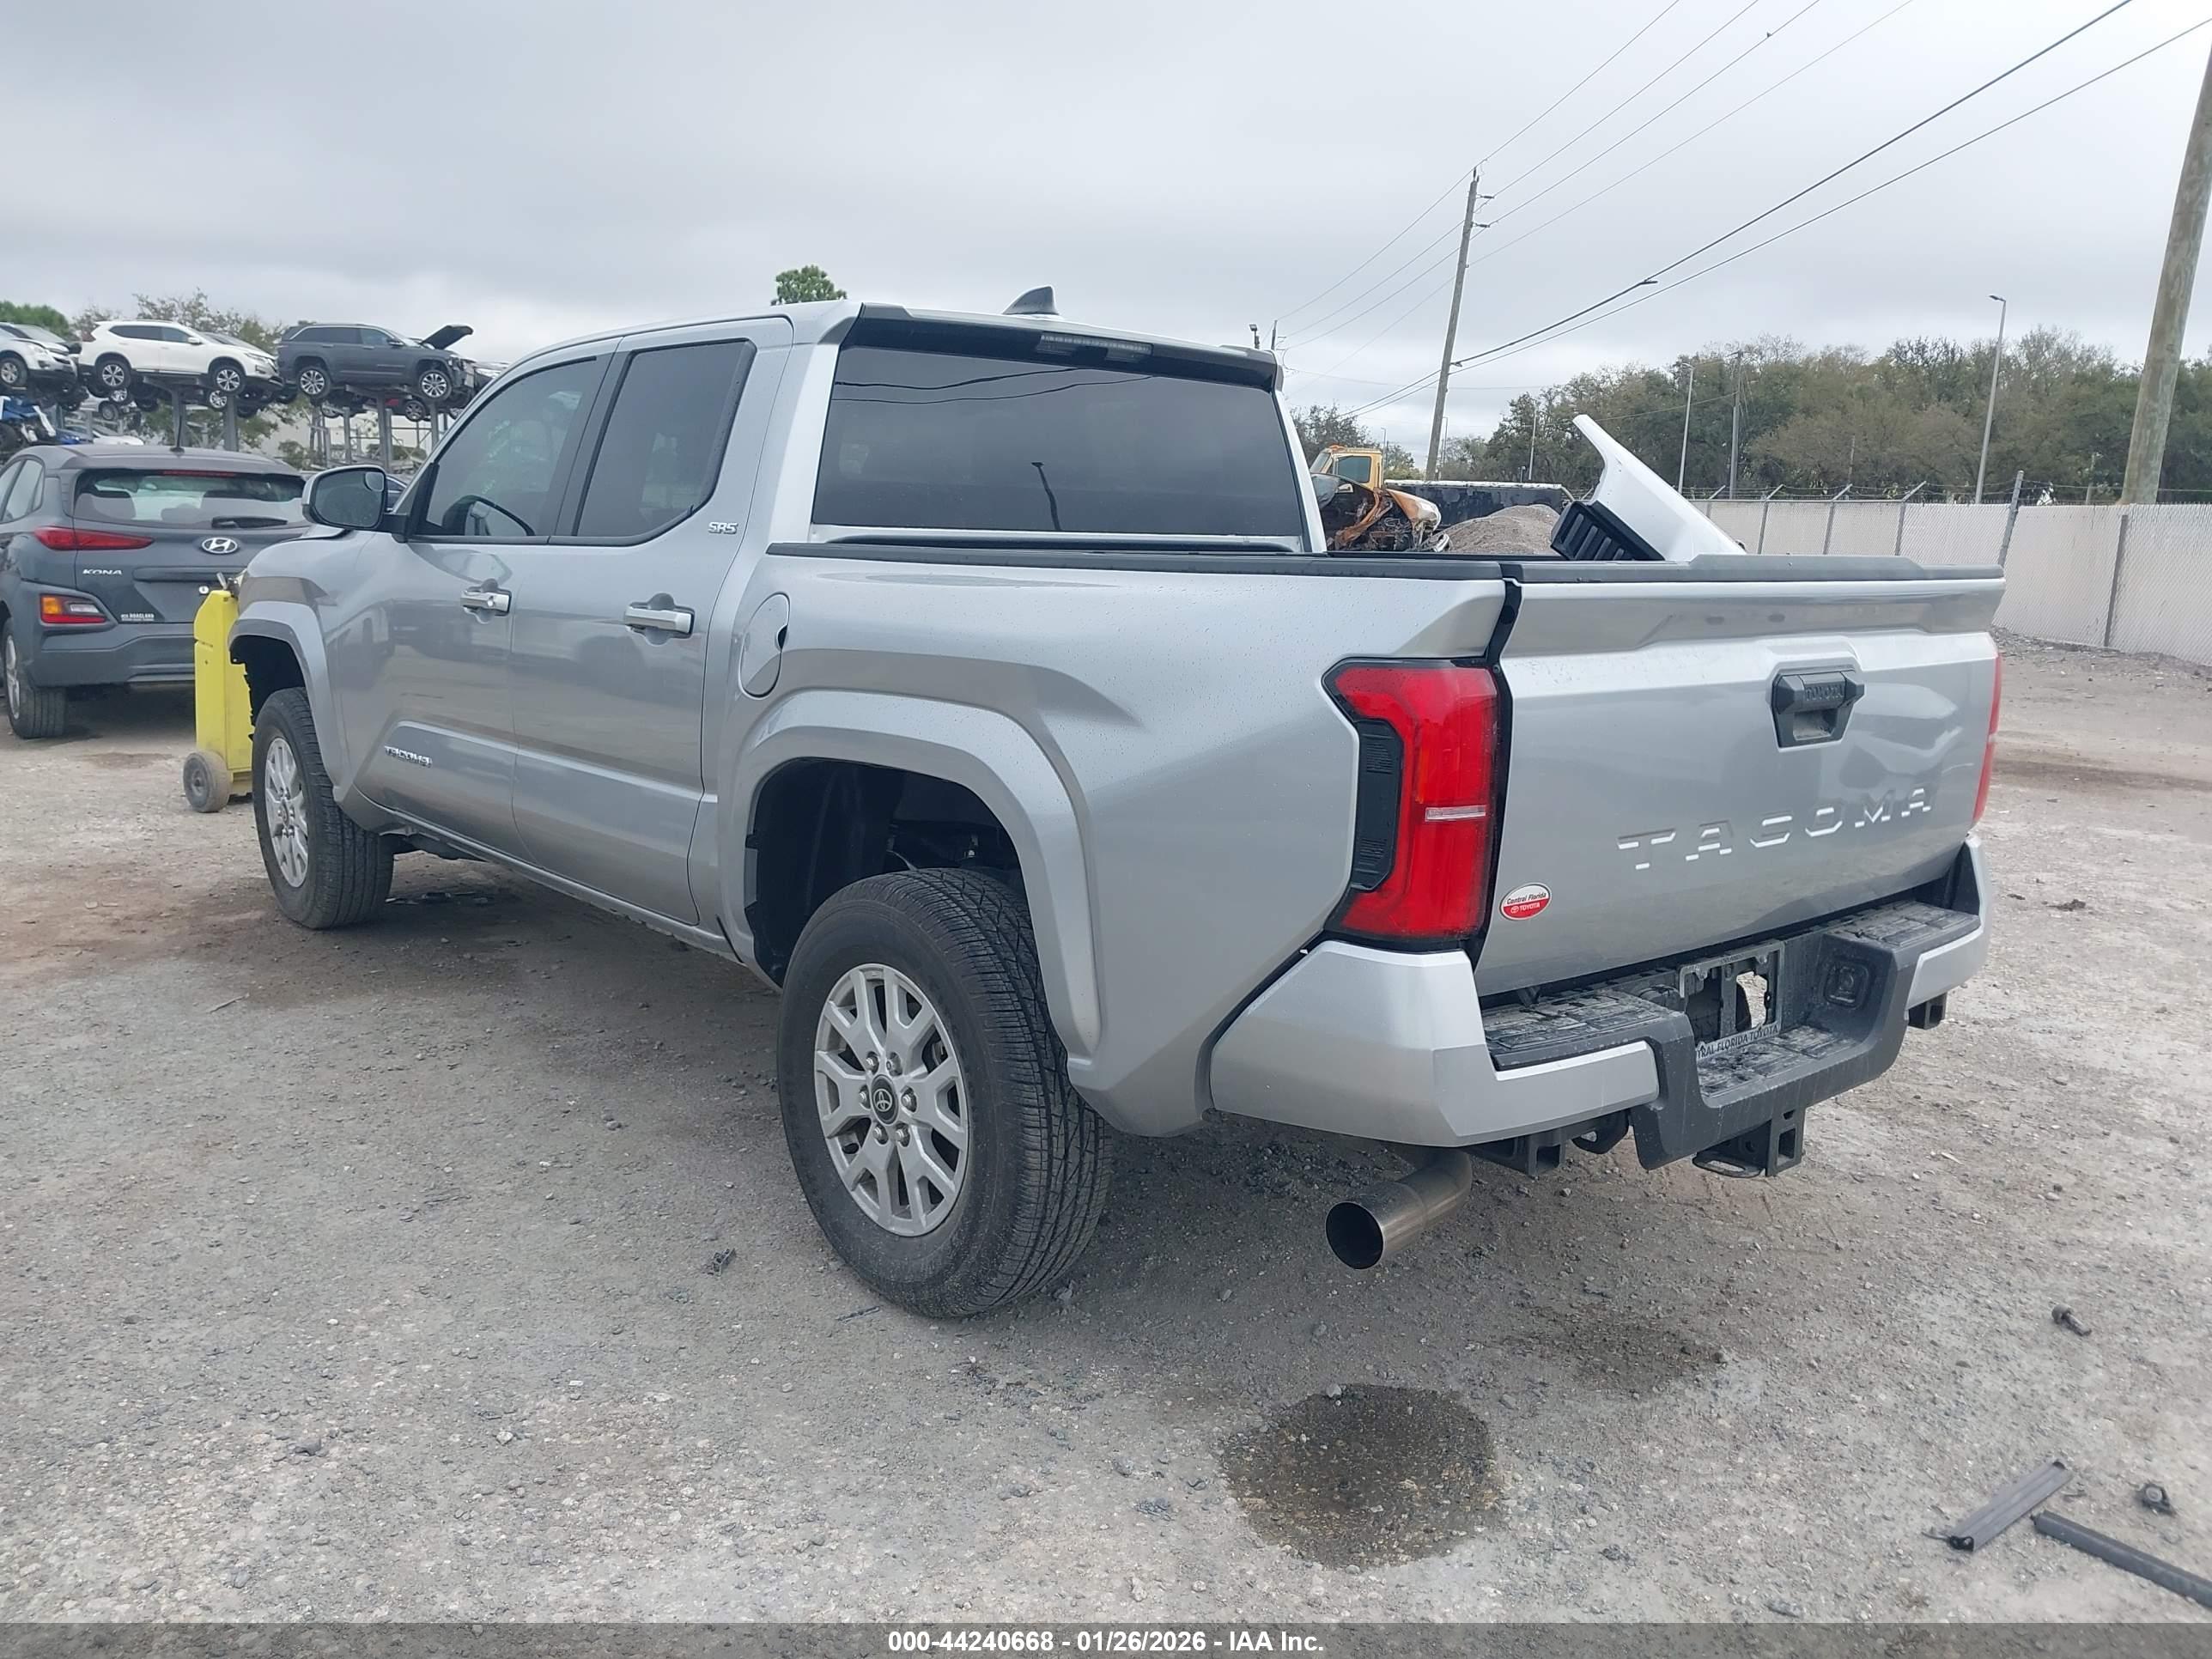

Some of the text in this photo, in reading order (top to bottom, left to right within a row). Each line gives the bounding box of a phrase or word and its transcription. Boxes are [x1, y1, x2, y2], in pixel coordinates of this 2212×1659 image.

[708, 521, 738, 534] SR5
[384, 744, 433, 768] TACOMA
[1617, 787, 1931, 871] TACOMA
[1507, 892, 1547, 904] Central Florida
[1519, 902, 1540, 912] TOYOTA
[1718, 1034, 1748, 1050] FLORIDA
[1750, 1025, 1778, 1041] TOYOTA
